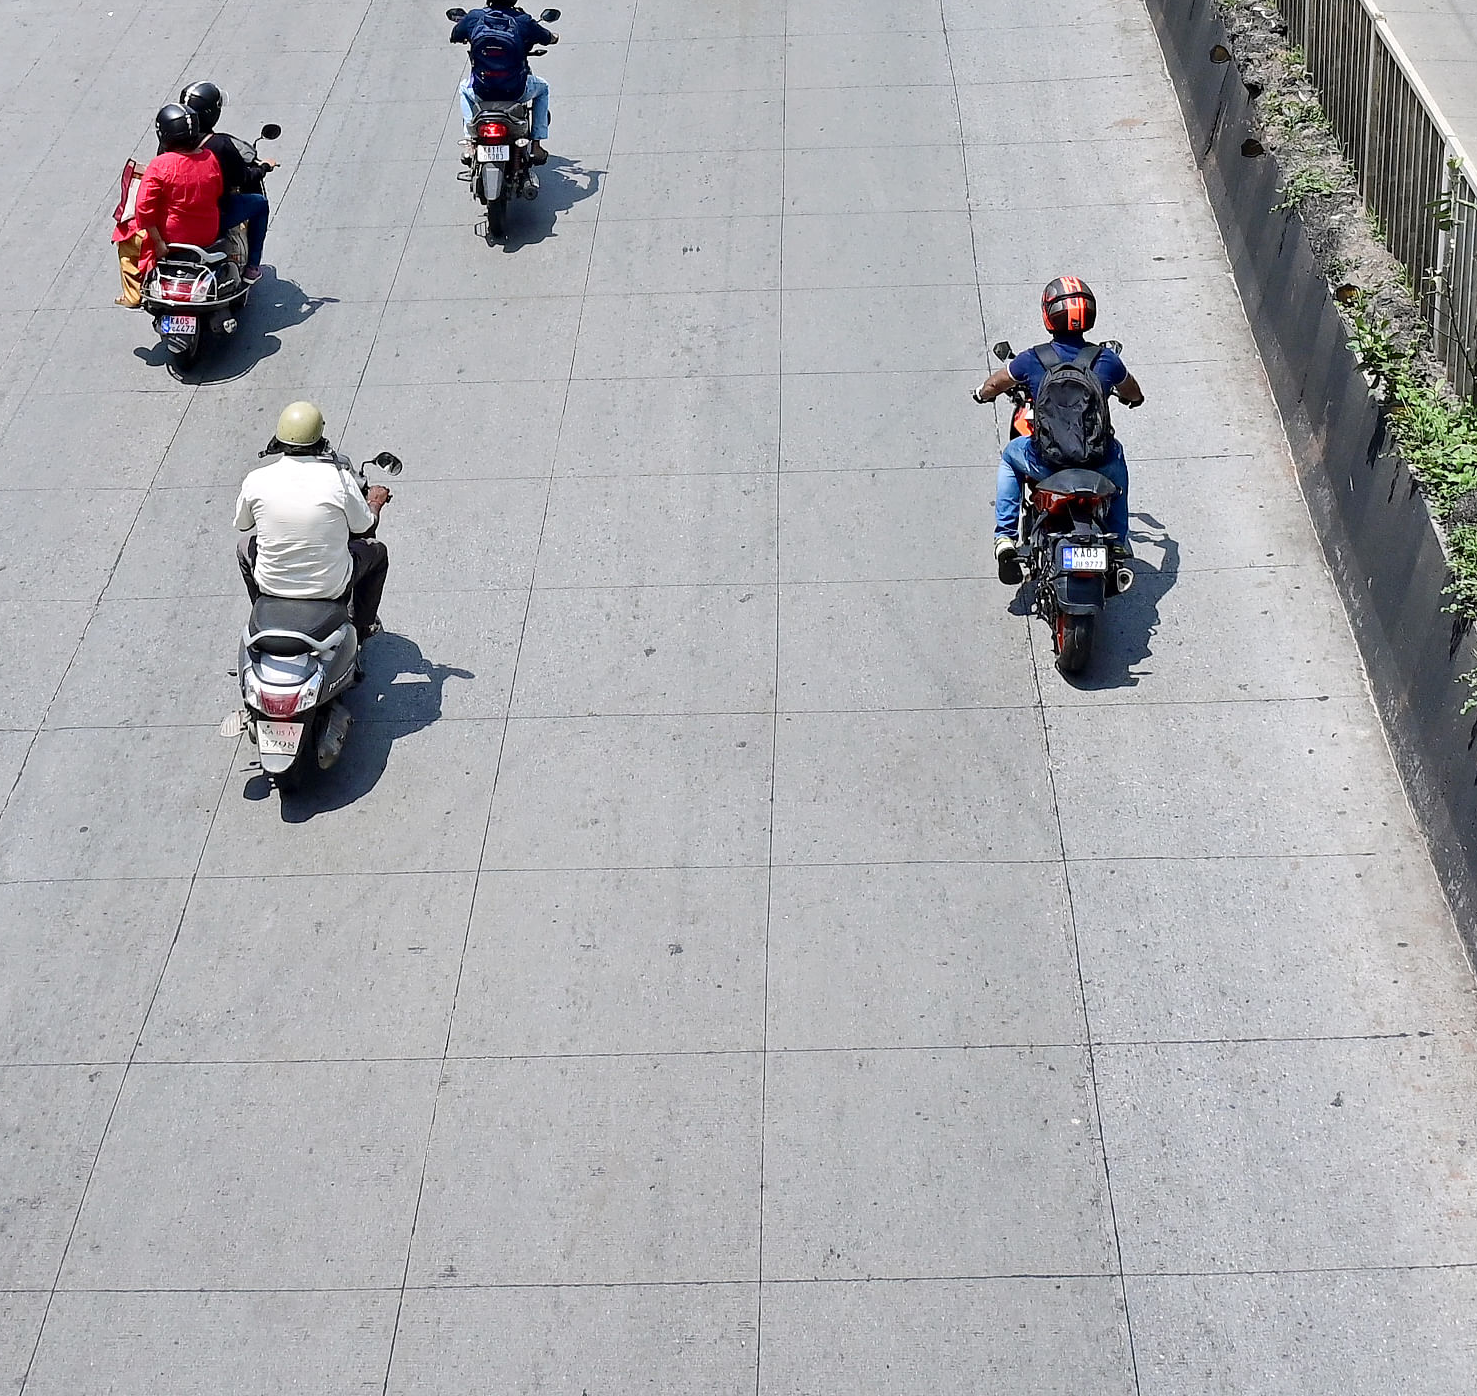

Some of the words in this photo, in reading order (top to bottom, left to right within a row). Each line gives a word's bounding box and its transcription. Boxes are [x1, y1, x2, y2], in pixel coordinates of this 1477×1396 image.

[170, 317, 190, 325] KA05
[1073, 547, 1098, 558] KA03
[263, 740, 295, 749] 3798
